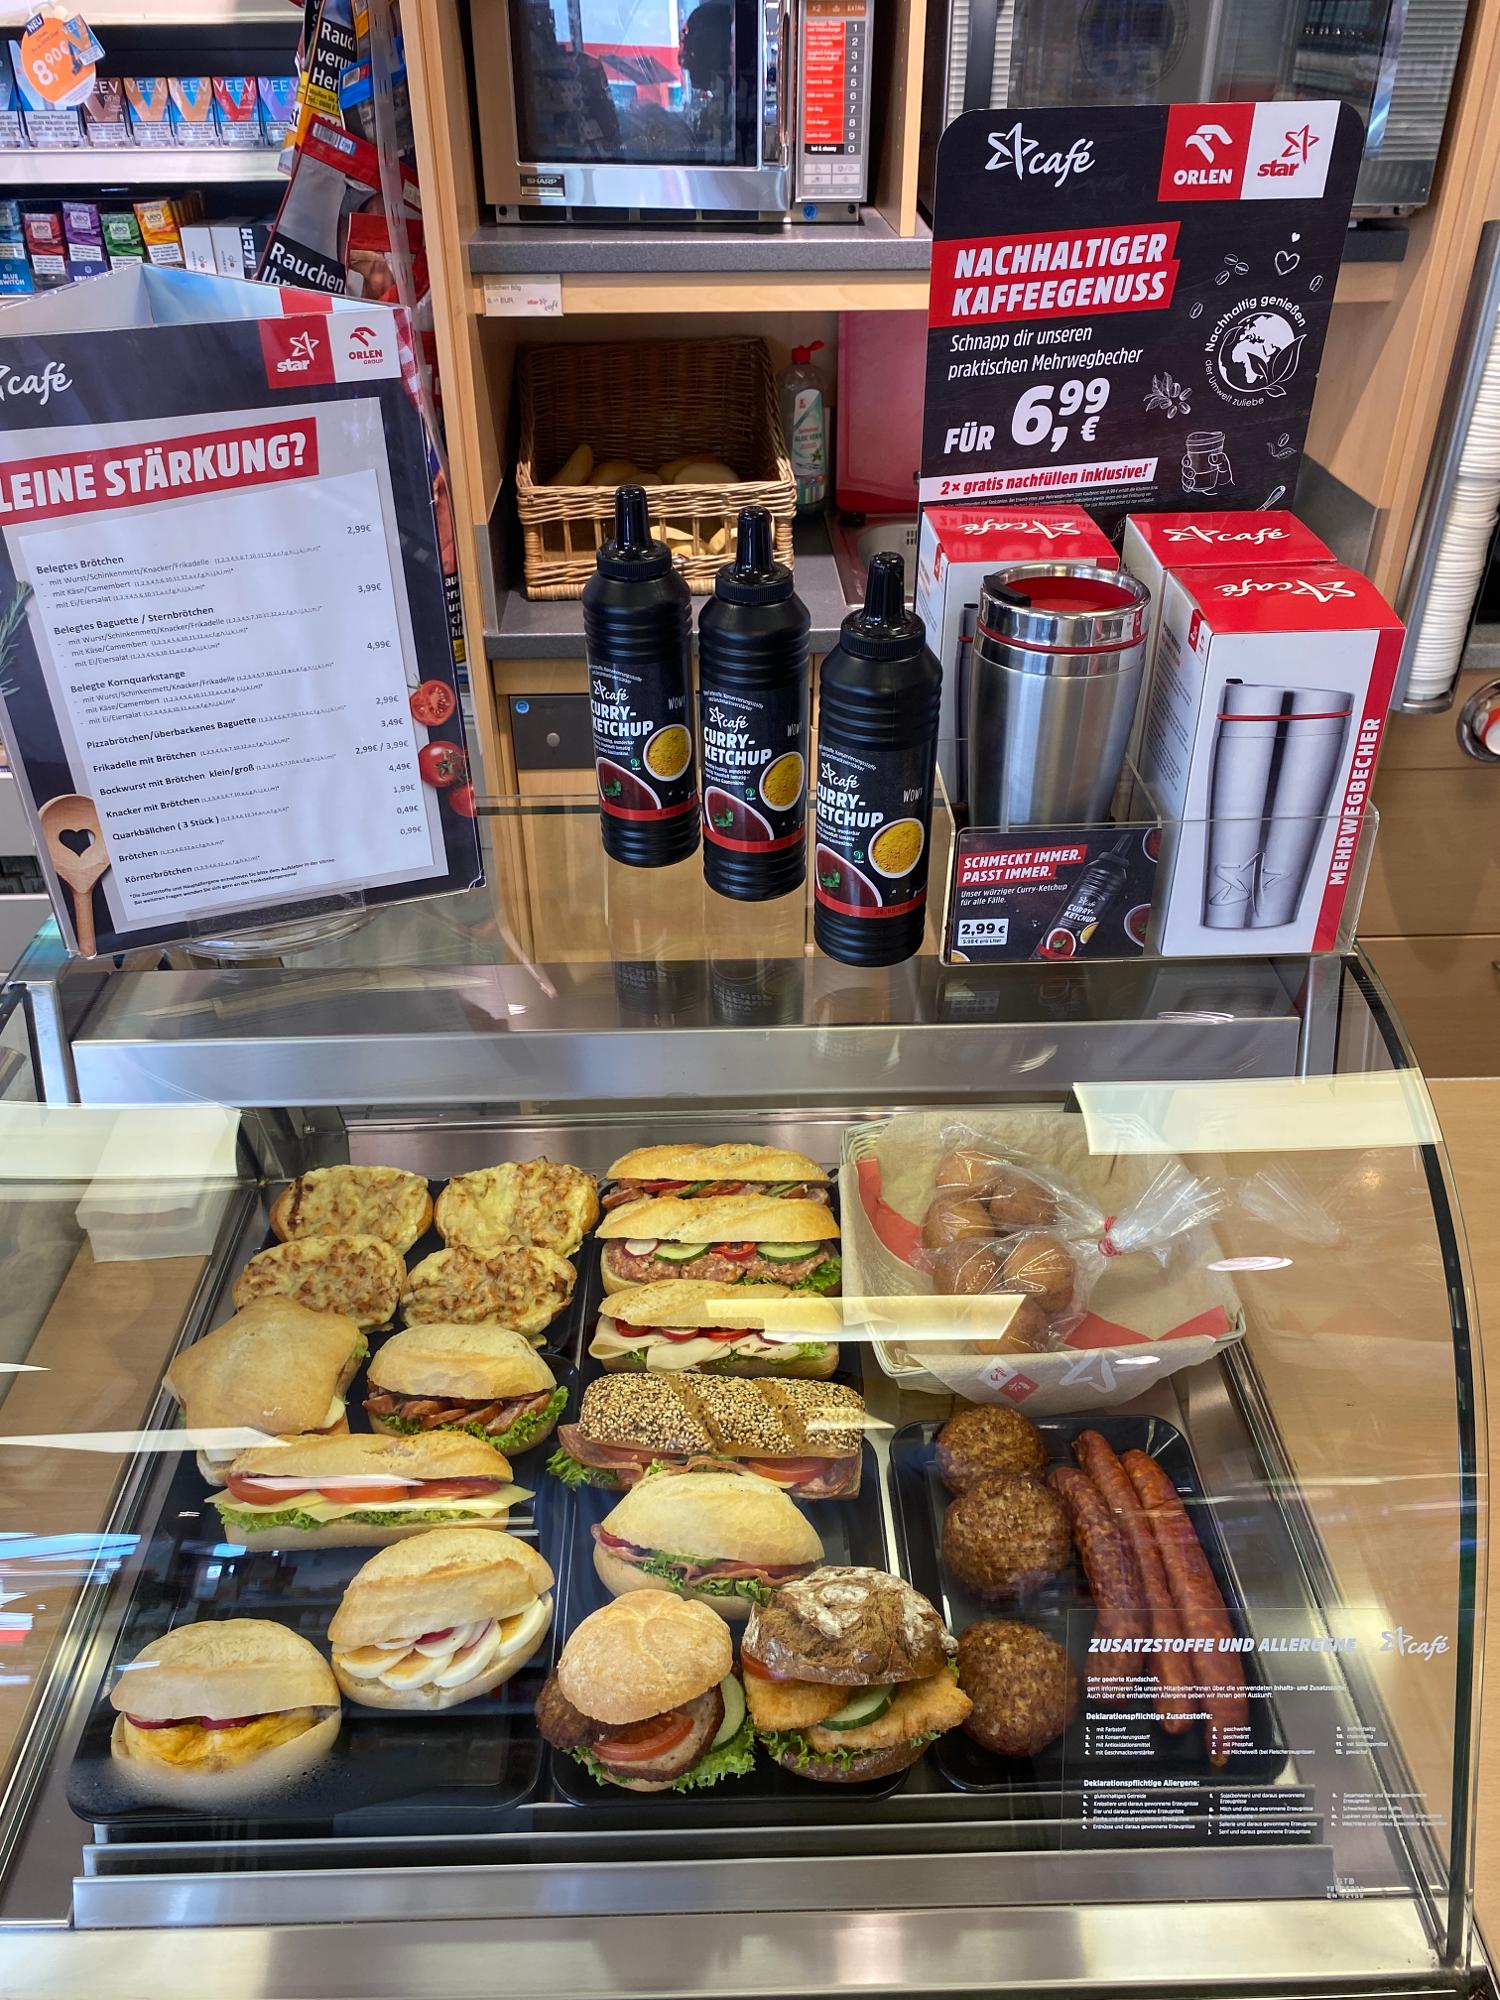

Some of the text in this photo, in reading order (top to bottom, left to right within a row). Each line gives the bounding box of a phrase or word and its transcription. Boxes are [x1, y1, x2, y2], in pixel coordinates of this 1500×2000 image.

[26, 16, 43, 33] NEU
[853, 24, 858, 32] 1
[852, 37, 858, 46] 2
[851, 51, 858, 60] 3
[851, 65, 857, 73] 4
[213, 80, 255, 93] VEEV
[850, 78, 857, 87] 5
[850, 92, 857, 100] 6
[850, 105, 856, 113] 7
[849, 118, 856, 127] 8
[848, 132, 856, 140] 9
[848, 145, 855, 153] 0
[1028, 139, 1095, 188] café
[1256, 160, 1299, 178] star
[1173, 169, 1233, 186] ORLEN
[954, 233, 1168, 279] NACHHALTIGER
[269, 242, 344, 294] Rauchen
[951, 271, 1168, 317] KAFFEEGENUSS
[1260, 295, 1306, 327] genießen
[1204, 298, 1257, 352] Nachhaltig
[950, 325, 1093, 353] Schnapp dir unseren
[348, 349, 383, 360] ORLEN
[276, 358, 310, 373] star
[947, 347, 1144, 381] praktischen Mehrwegbecher
[1204, 359, 1213, 375] der
[7, 361, 73, 405] café
[1208, 376, 1233, 403] Umwelt
[1232, 397, 1265, 407] zuliebe
[944, 377, 1110, 454] FÜR 6,99
[1080, 416, 1099, 442] €
[104, 432, 306, 498] STÄRKUNG?
[963, 476, 1004, 496] gratis
[1005, 466, 1078, 491] nachfüllen
[347, 524, 372, 535] 2,99€
[959, 518, 1030, 536] café
[1216, 527, 1291, 545] café
[36, 555, 125, 575] Belegtes Brötchen
[49, 577, 63, 586] mit
[64, 558, 210, 584] Wurst/Schinkenmett/Knacker/Frikadelle
[52, 589, 66, 598] mit
[67, 580, 131, 595] Käse/Camembert
[357, 582, 382, 594] 3,99€
[1213, 578, 1295, 597] café
[55, 595, 112, 609] mit Ei/Eiersalat
[54, 623, 95, 635] Belegtes
[96, 616, 139, 630] Baguette
[147, 606, 214, 622] Sternbrötchen
[83, 618, 225, 643] Wurst/Schinkenmett/Knacker/Frikadelle
[71, 649, 85, 657] mit
[85, 641, 148, 655] Käse/Camembert
[367, 640, 391, 651] 4,99€
[88, 655, 129, 667] Ei/Eiersalat
[70, 670, 186, 694] Belegte Kornquarkstange
[82, 695, 96, 704] mit
[96, 675, 236, 701] Wurst/Schinkenmett/Knacker/Frikadelle
[375, 695, 399, 705] 2,99€
[605, 687, 629, 705] café
[85, 706, 98, 714] mit
[99, 697, 160, 713] Käse/Camembert
[591, 699, 637, 721] CURRY-
[88, 711, 142, 725] mit Ei/Eiersalat
[380, 717, 404, 728] 3,49€
[592, 715, 654, 737] KETCHUP
[722, 715, 749, 733] café
[86, 722, 216, 750] Pizzabrötchen/überbackenes
[216, 716, 257, 733] Baguette
[703, 726, 756, 749] CURRY-
[355, 744, 378, 755] 2,99€
[386, 740, 409, 750] 3,99€
[704, 742, 772, 766] KETCHUP
[92, 750, 197, 773] Frikadelle mit Brötchen
[388, 762, 412, 772] 4,49€
[99, 763, 255, 796] Bockwurst mit Brötchen klein/groß
[833, 774, 860, 793] café
[393, 784, 416, 794] 1,99€
[817, 781, 866, 809] CURRY-
[106, 797, 200, 819] Knacker mit Brötchen
[396, 804, 419, 815] 0,49€
[1329, 717, 1381, 886] MEHRWEGBECHER
[817, 799, 884, 828] KETCHUP
[112, 822, 176, 841] Quarkbällchen
[183, 820, 189, 829] 3
[190, 815, 214, 827] Stück
[400, 826, 422, 836] 0,99€
[118, 849, 159, 863] Brötchen
[963, 848, 1082, 869] SCHMECKT IMMER.
[125, 865, 193, 884] Körnerbrötchen
[962, 865, 1052, 883] PASST IMMER.
[961, 882, 1068, 898] Unser würziger Curry-Ketchup
[960, 896, 1006, 906] für alle Fälle.
[1066, 903, 1094, 915] CURRY-
[1063, 910, 1097, 923] KETCHUP
[961, 923, 1005, 936] 2,99 €
[1088, 1637, 1358, 1653] ZUSATZSTOFFE UND ALLERGENE
[1407, 1634, 1450, 1661] café
[1086, 1712, 1213, 1721] Deklarationspflichtige Zusatzstoffe:
[1083, 1779, 1200, 1788] Deklarationspflichtige Allergene:
